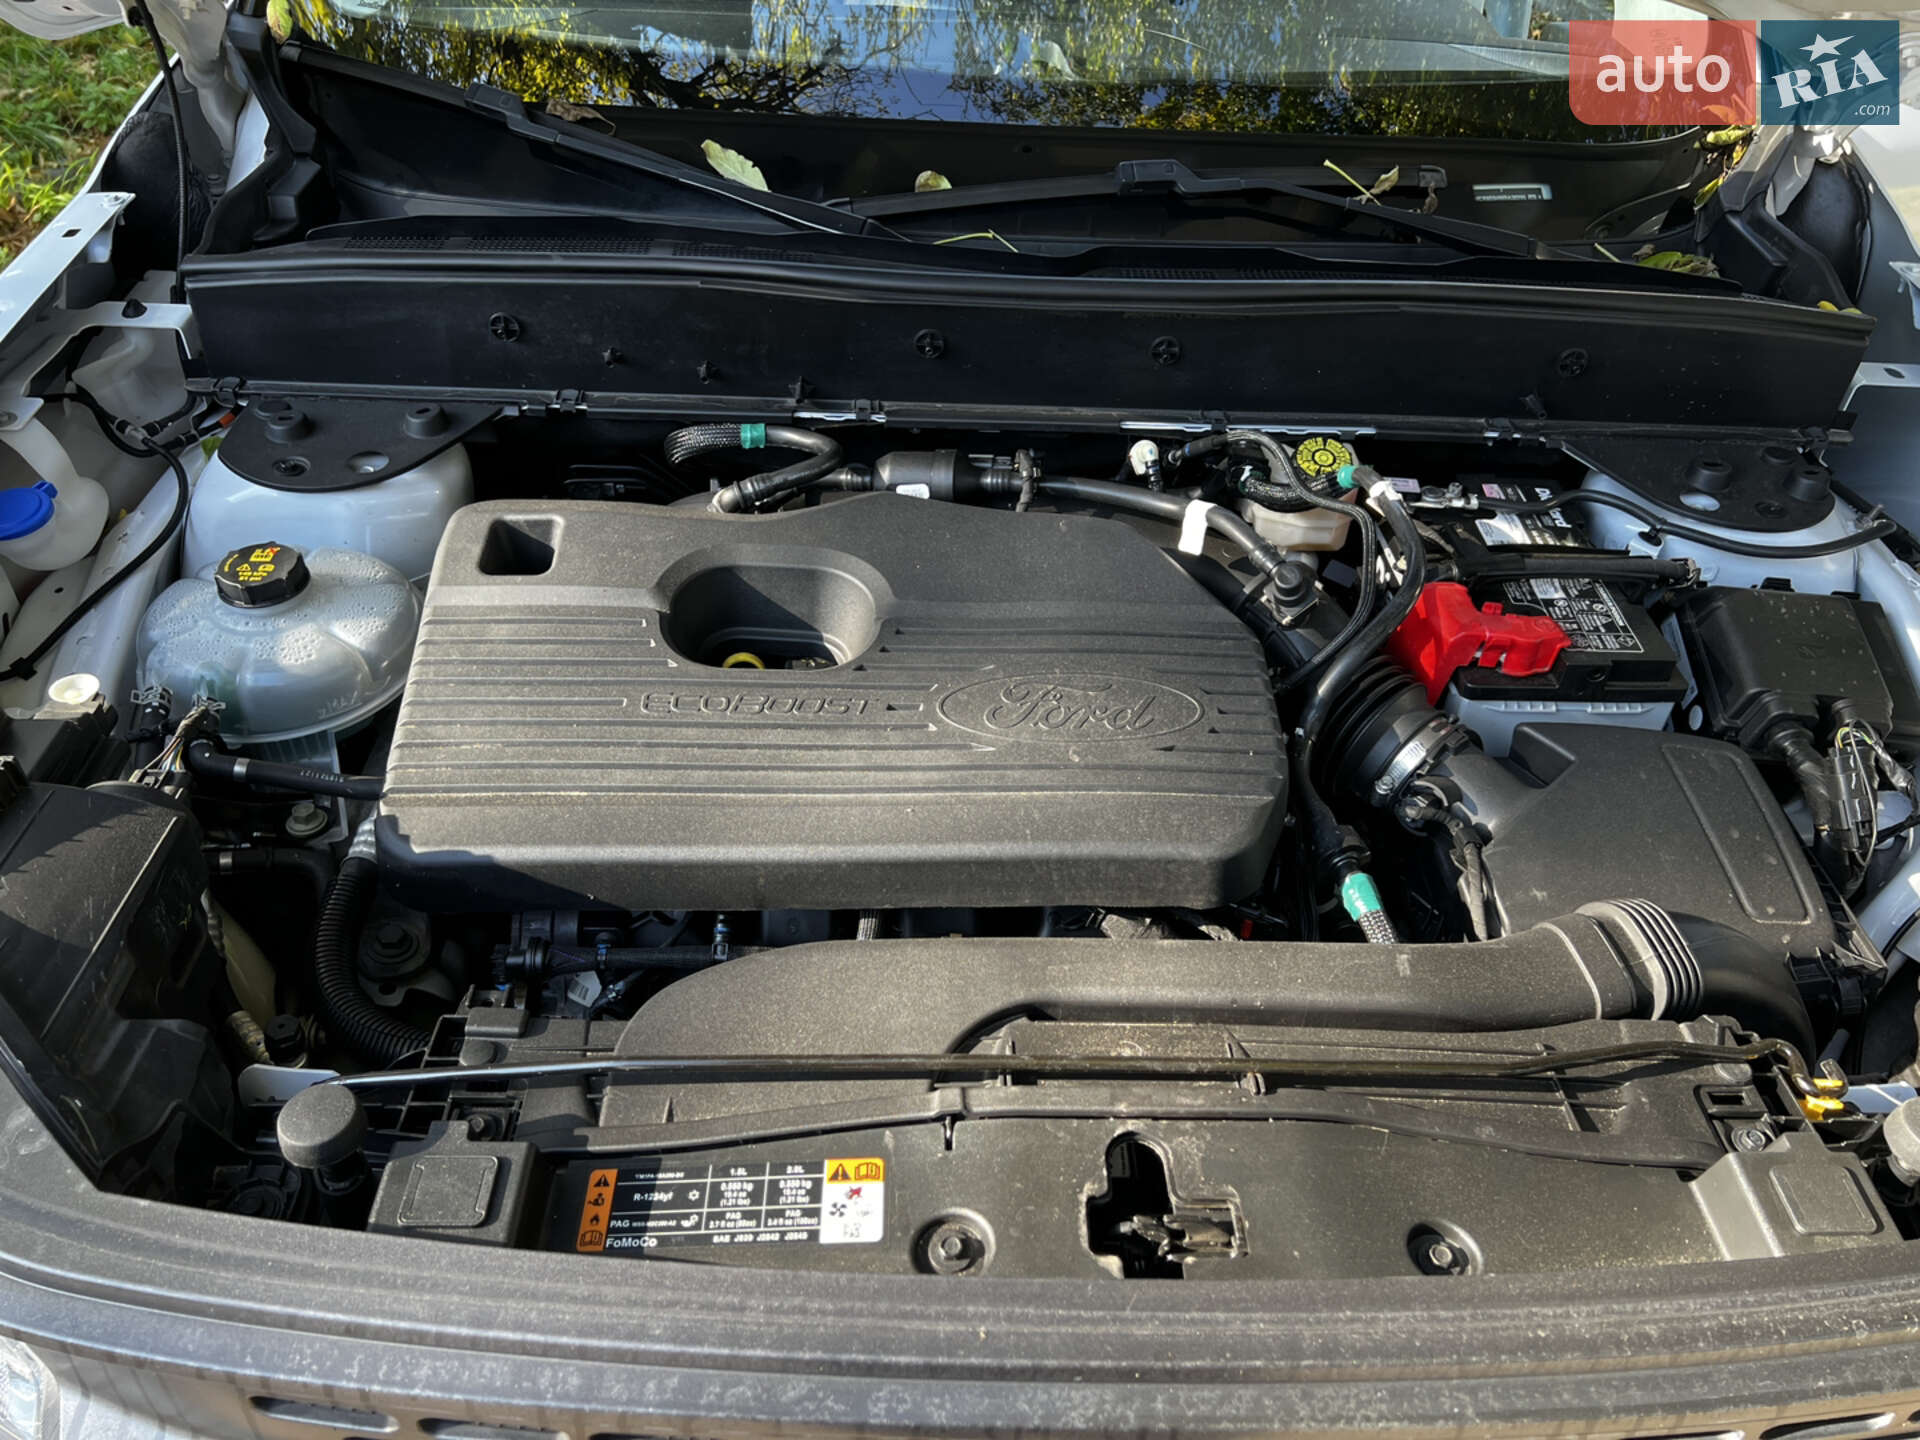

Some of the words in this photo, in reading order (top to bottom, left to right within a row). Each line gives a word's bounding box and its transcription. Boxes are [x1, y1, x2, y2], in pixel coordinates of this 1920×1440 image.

[640, 692, 880, 716] ECOBOOST
[984, 683, 1156, 730] Ford
[634, 1192, 674, 1202] R-1234yf
[606, 1236, 658, 1248] FoMoCo
